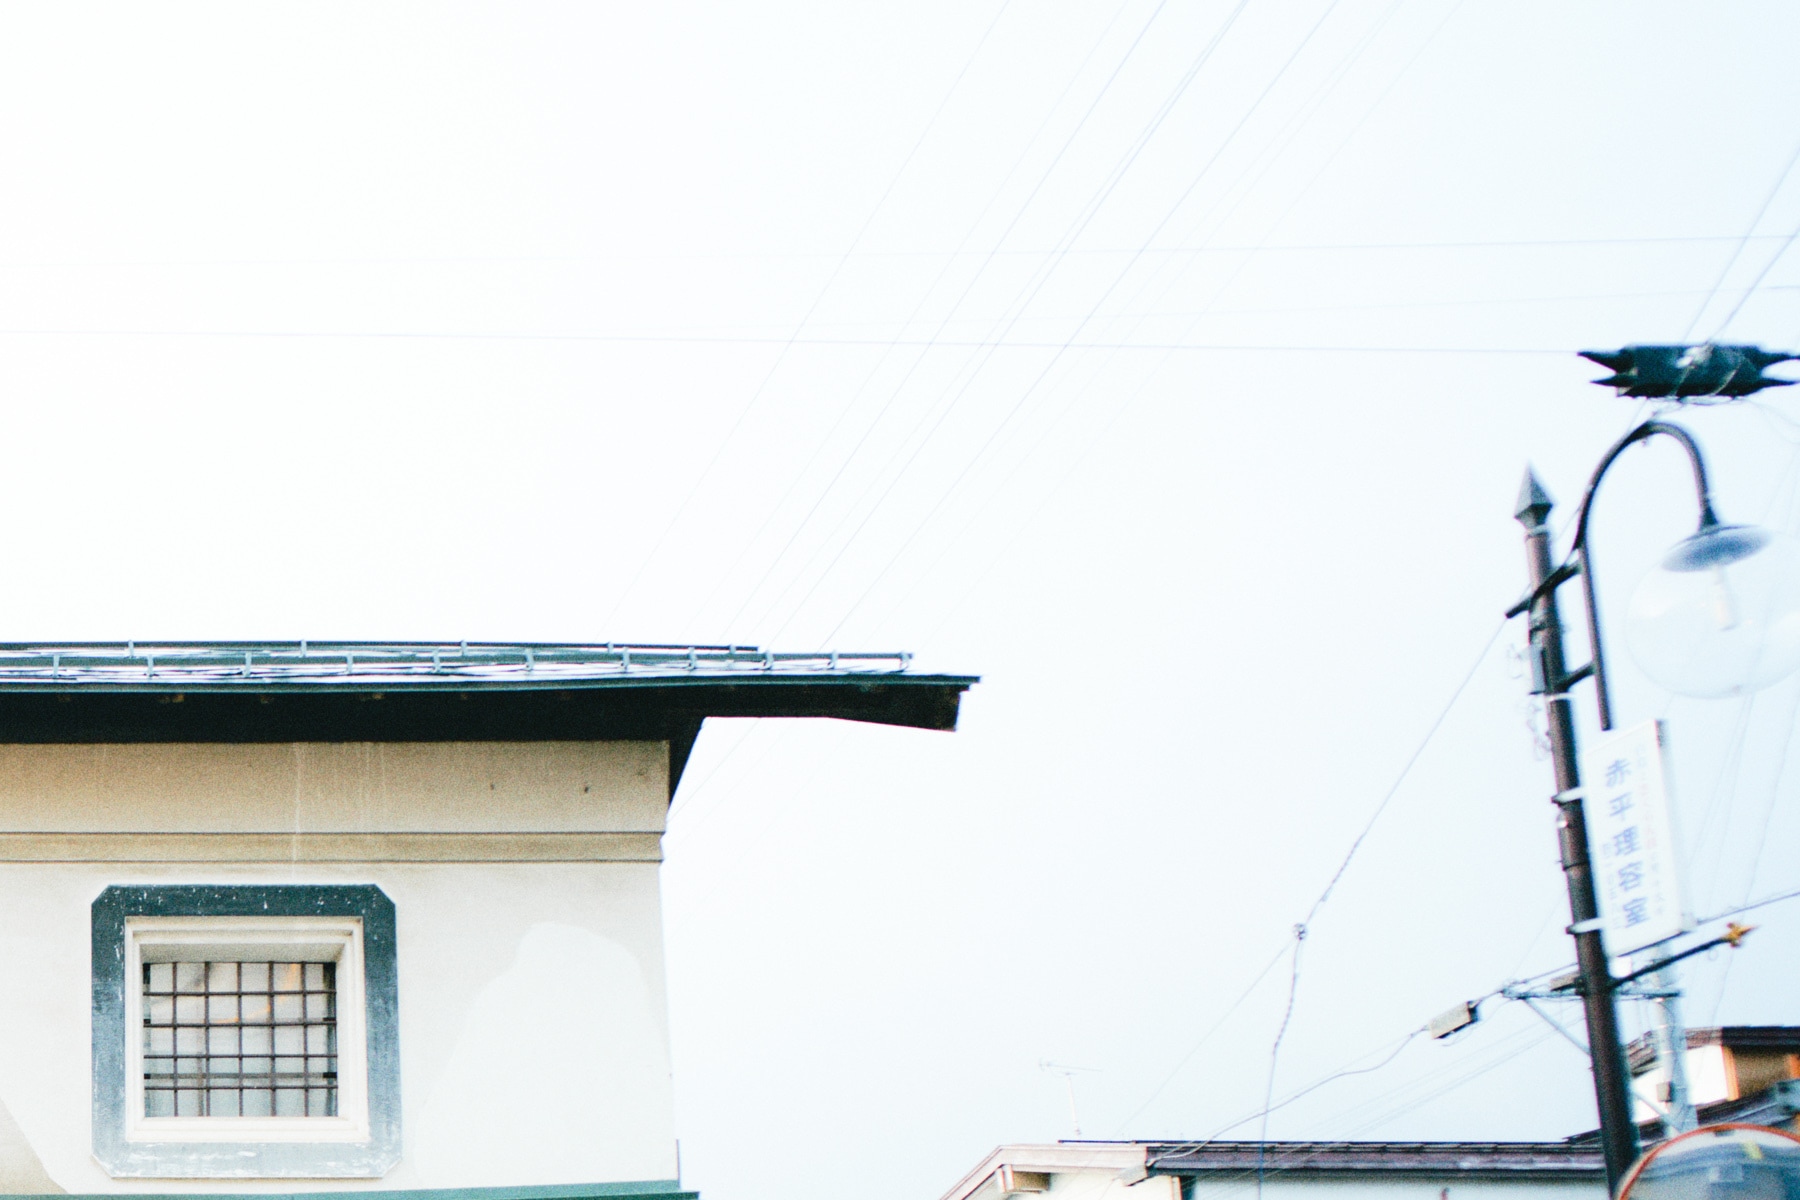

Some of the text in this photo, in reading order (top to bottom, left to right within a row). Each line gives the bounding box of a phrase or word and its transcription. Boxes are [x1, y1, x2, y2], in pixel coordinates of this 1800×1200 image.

[1605, 757, 1651, 928] 赤平理容室
